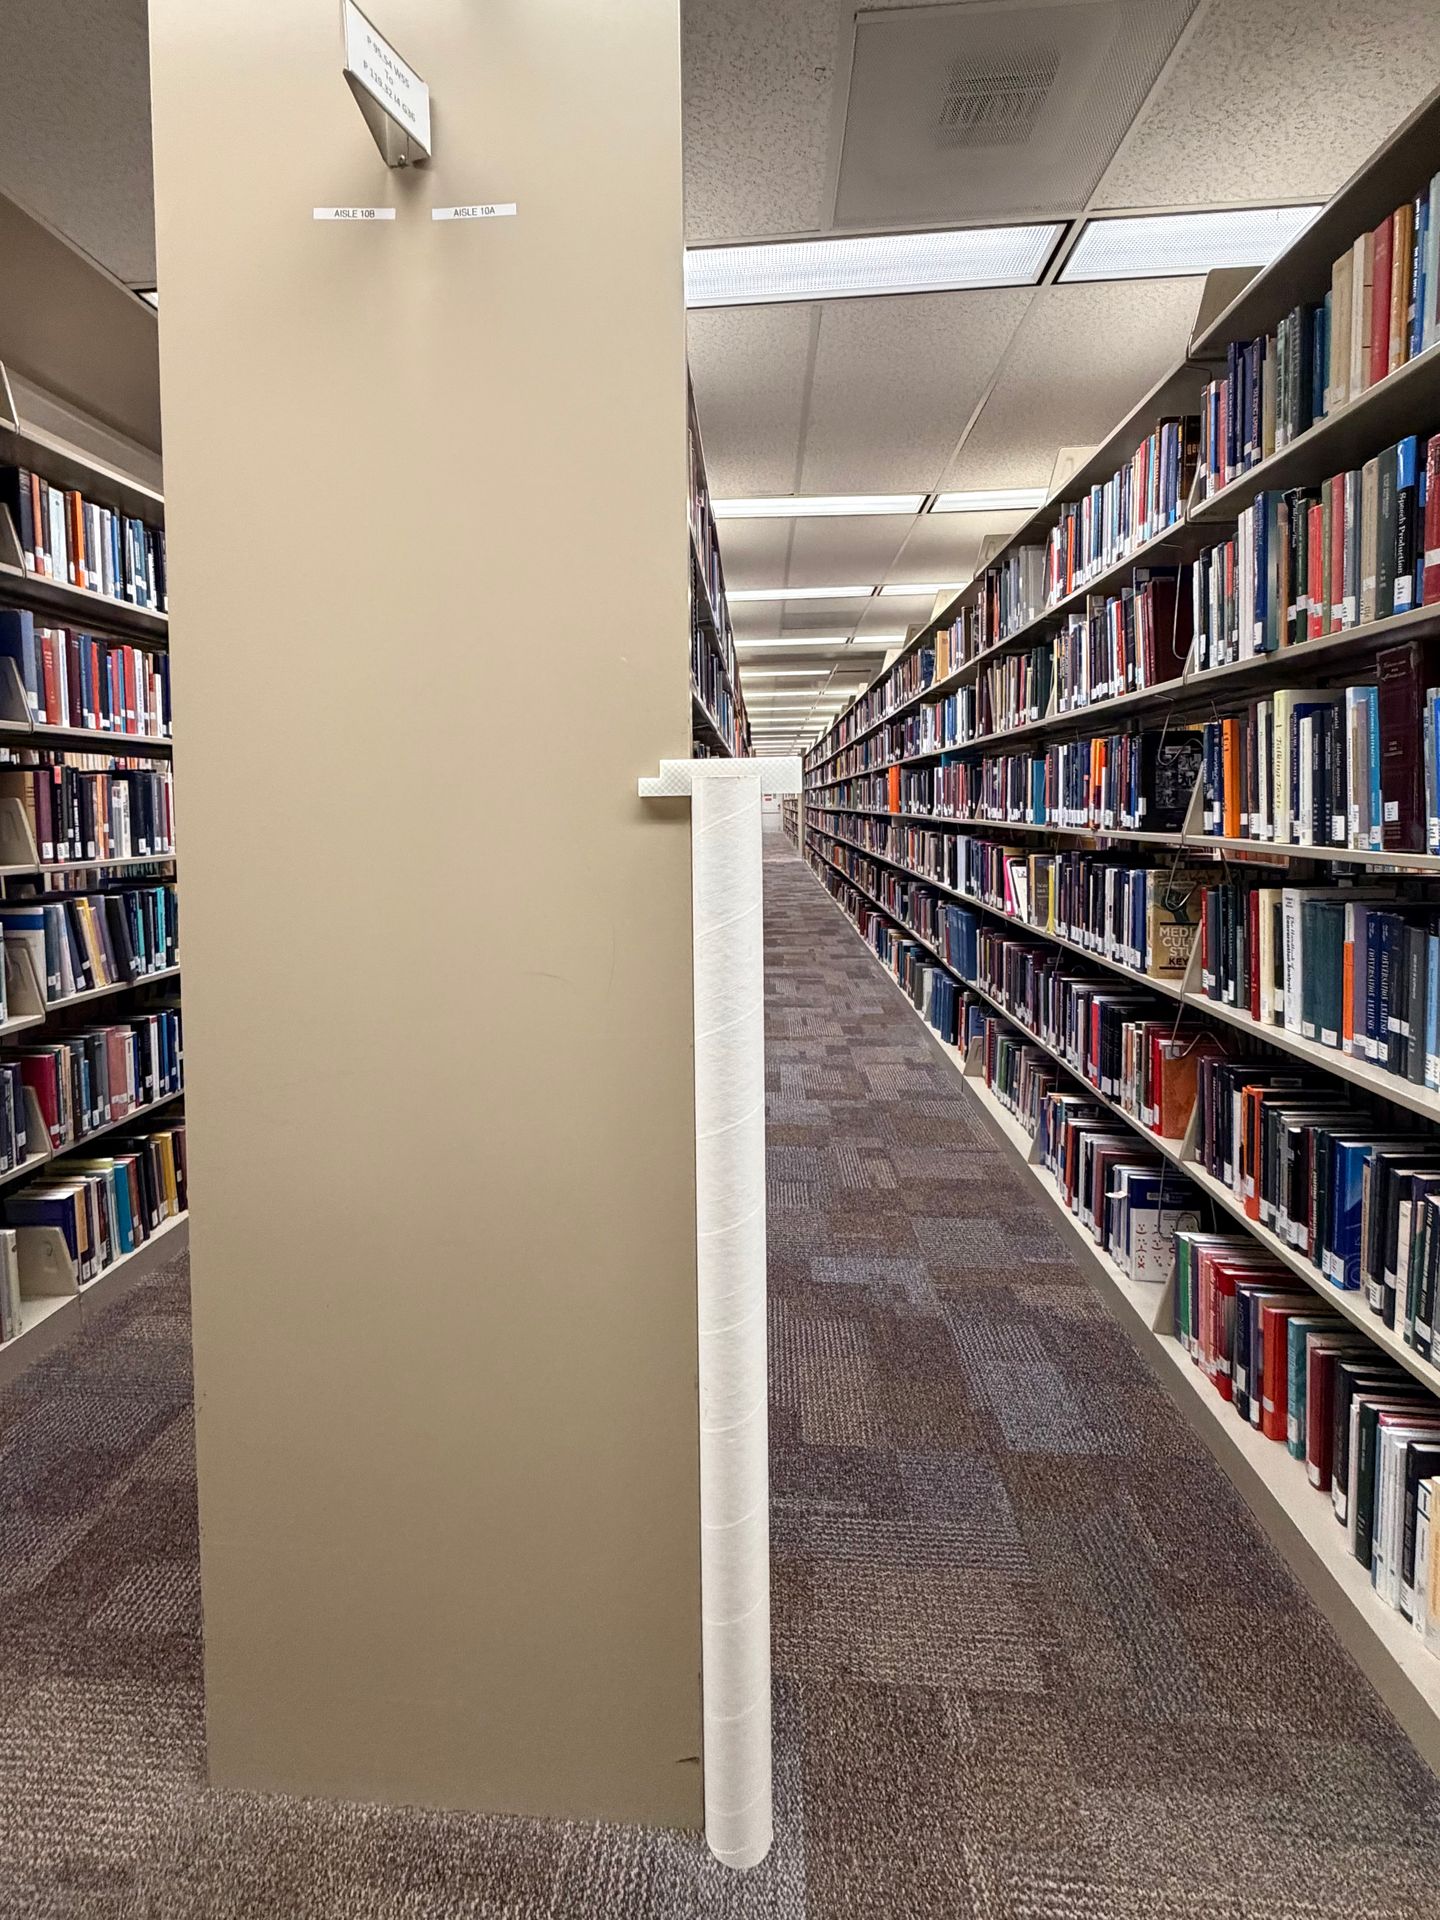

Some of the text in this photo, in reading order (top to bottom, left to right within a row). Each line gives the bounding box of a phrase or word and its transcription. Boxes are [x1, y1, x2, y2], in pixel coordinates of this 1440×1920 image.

[384, 68, 394, 86] To
[334, 209, 375, 218] AISLE 10B
[453, 207, 496, 217] AISLE 10A
[1396, 492, 1407, 574] Speech Production
[1275, 736, 1283, 777] Talking
[1169, 957, 1189, 966] KEY
[1367, 948, 1376, 1030] CONVERSATION ANALYSIS
[1379, 951, 1389, 1034] CONVERSATION ANALYSIS
